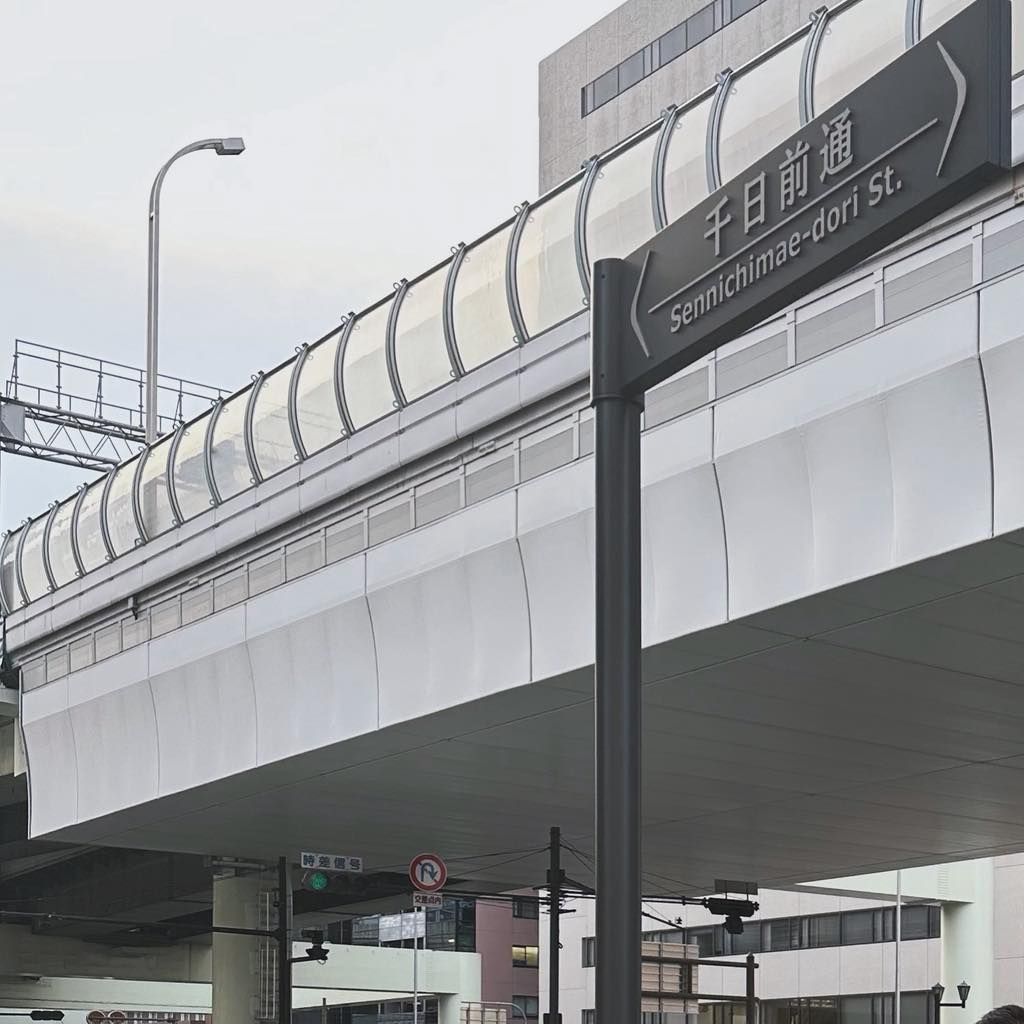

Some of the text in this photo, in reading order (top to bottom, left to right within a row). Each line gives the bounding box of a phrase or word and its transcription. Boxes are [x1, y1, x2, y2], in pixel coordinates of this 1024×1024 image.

[669, 165, 903, 333] Sennichimae-dori St.
[704, 107, 854, 256] 千日前通
[303, 854, 361, 871] 時差信号
